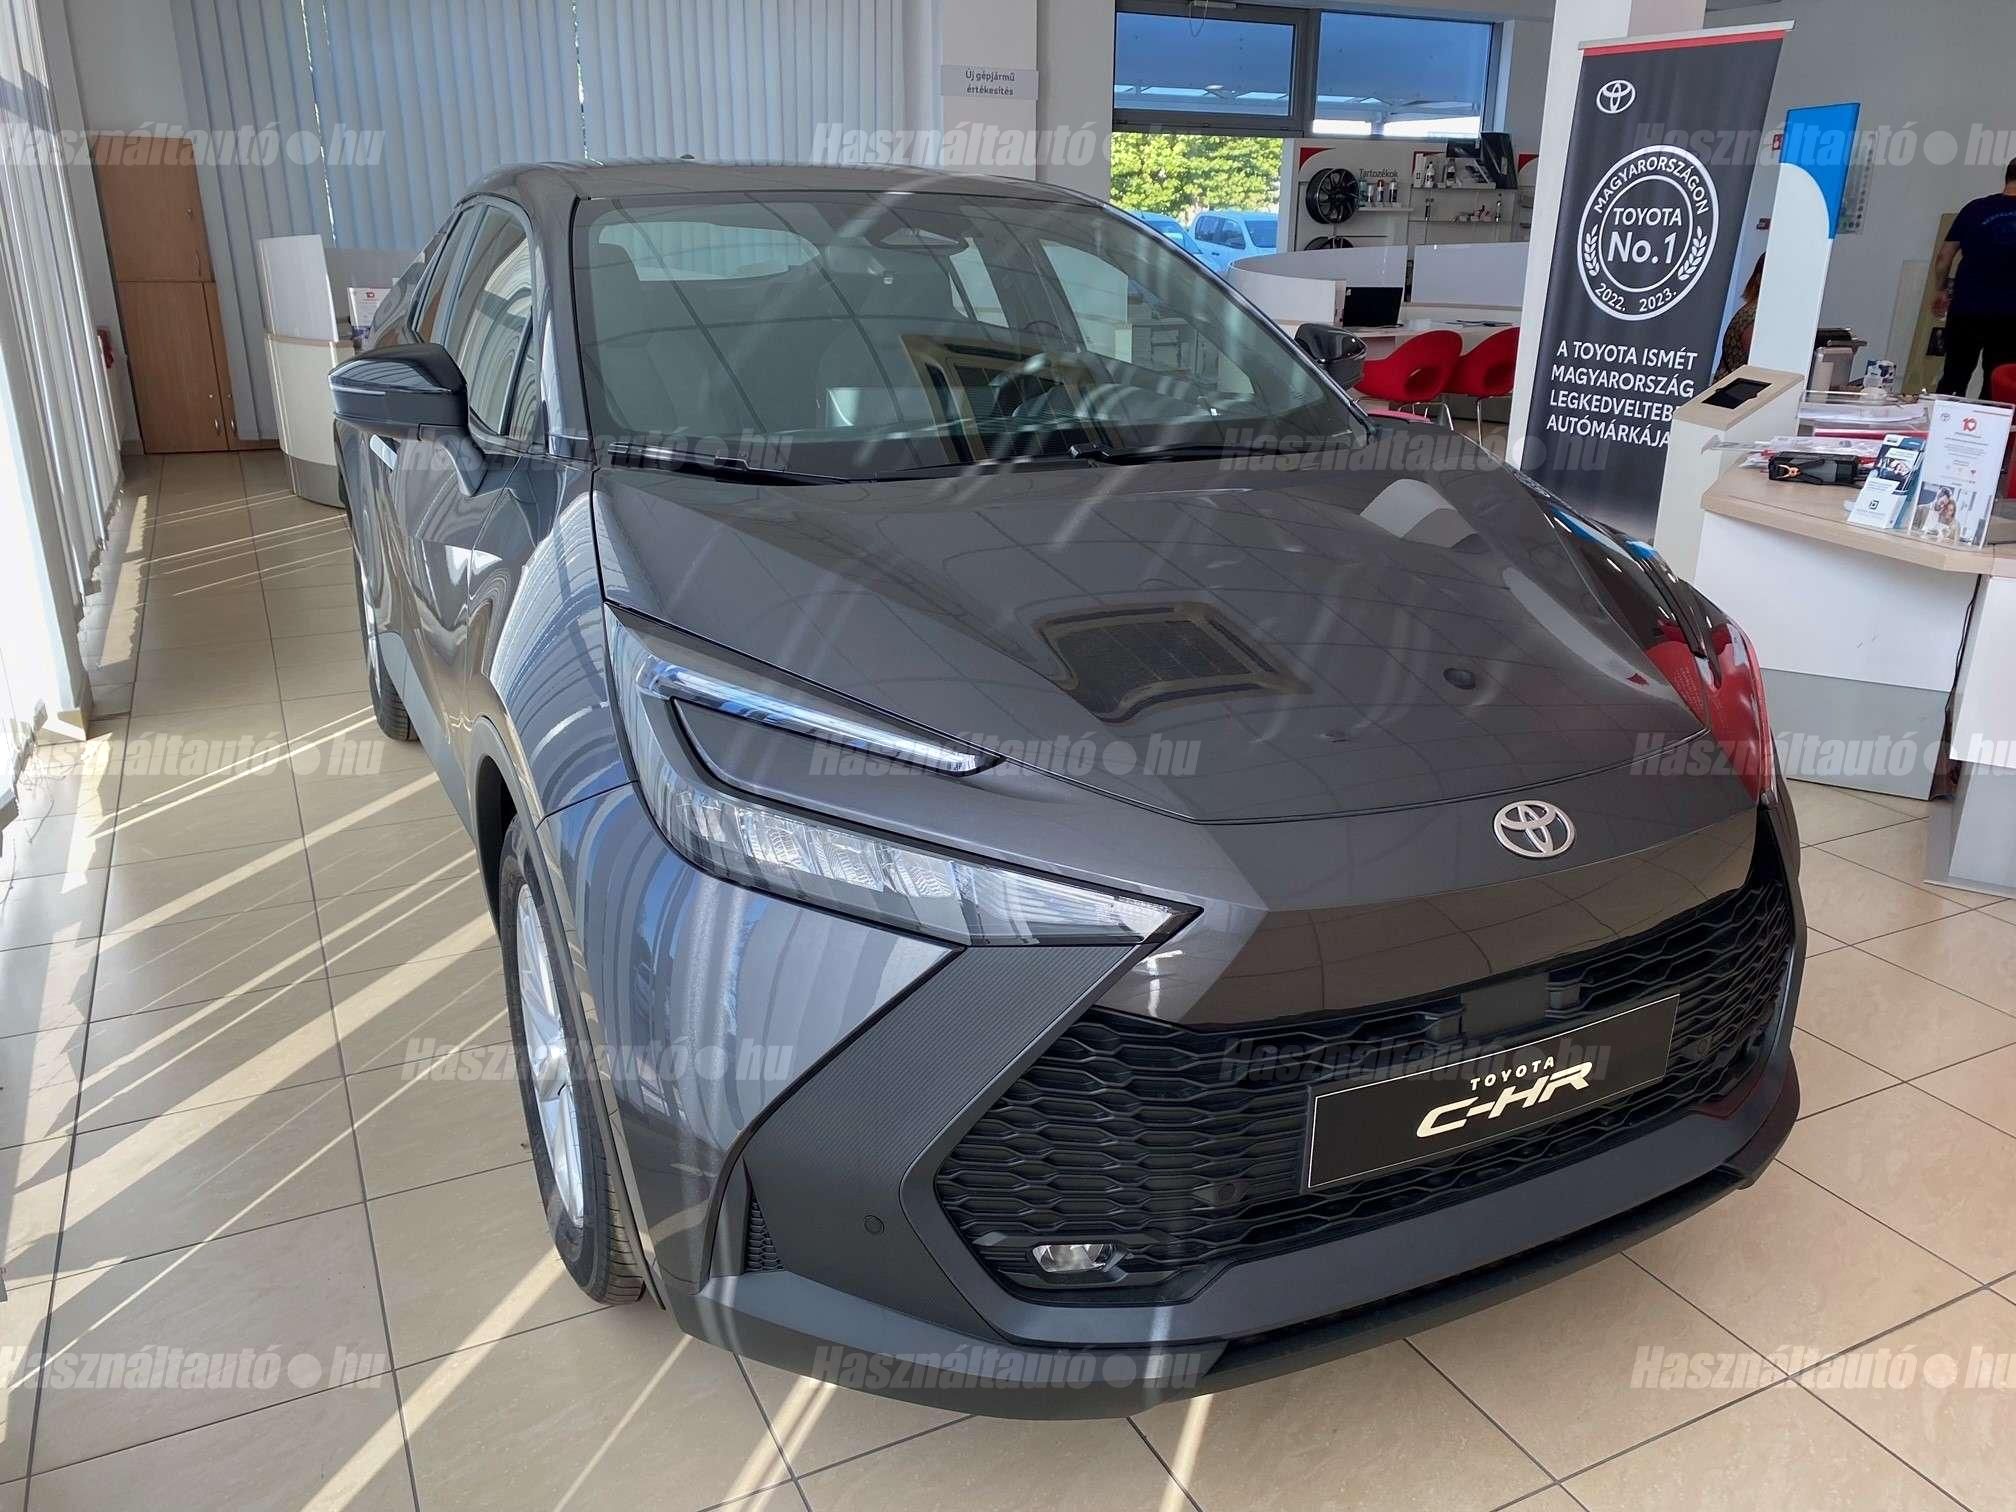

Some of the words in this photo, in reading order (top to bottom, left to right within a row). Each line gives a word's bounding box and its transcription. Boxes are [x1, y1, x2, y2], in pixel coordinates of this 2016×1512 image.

[1594, 156, 1710, 215] MAGYARORSZÁGON
[1613, 207, 1683, 226] TOYOTA
[1607, 231, 1677, 264] No.1
[1556, 340, 1568, 358] A
[1573, 341, 1637, 365] TOYOTA
[1642, 347, 1698, 371] ISMÉT
[1551, 364, 1695, 398] MAGYARORSZÁG
[1550, 389, 1680, 422] LEGKEDVELTEB
[1546, 414, 1672, 448] AUTÓMÁRKÁJA
[1470, 1056, 1556, 1091] TOYOTA
[1416, 1062, 1593, 1138] C-HR
